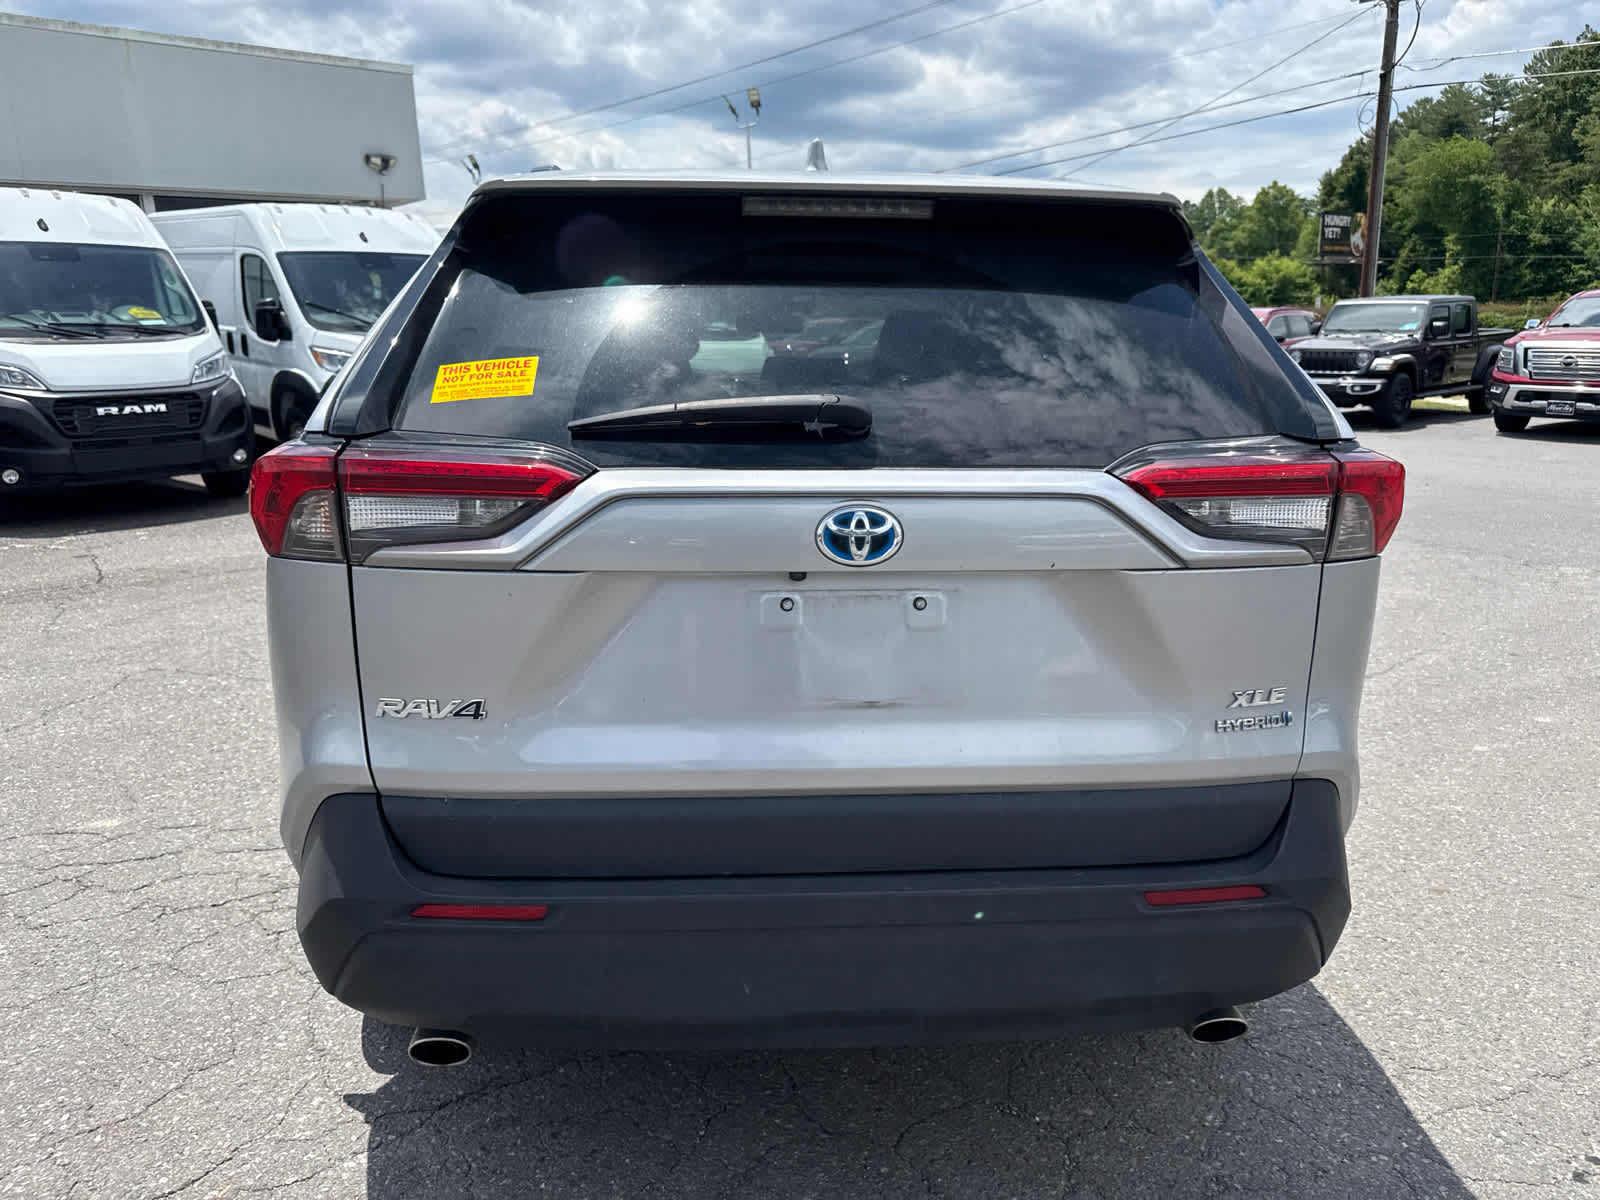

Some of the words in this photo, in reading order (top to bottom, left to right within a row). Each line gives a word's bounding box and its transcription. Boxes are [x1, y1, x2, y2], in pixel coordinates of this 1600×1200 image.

[1324, 214, 1352, 227] HUNGRY
[442, 364, 471, 376] THIS
[475, 359, 533, 372] VEHICLE
[442, 375, 465, 384] NOT
[468, 372, 493, 381] FOR
[496, 369, 528, 379] SALE
[96, 403, 168, 416] RAM
[1226, 687, 1288, 709] XLE
[375, 697, 488, 721] RAV4
[1215, 714, 1284, 733] HYBRID
